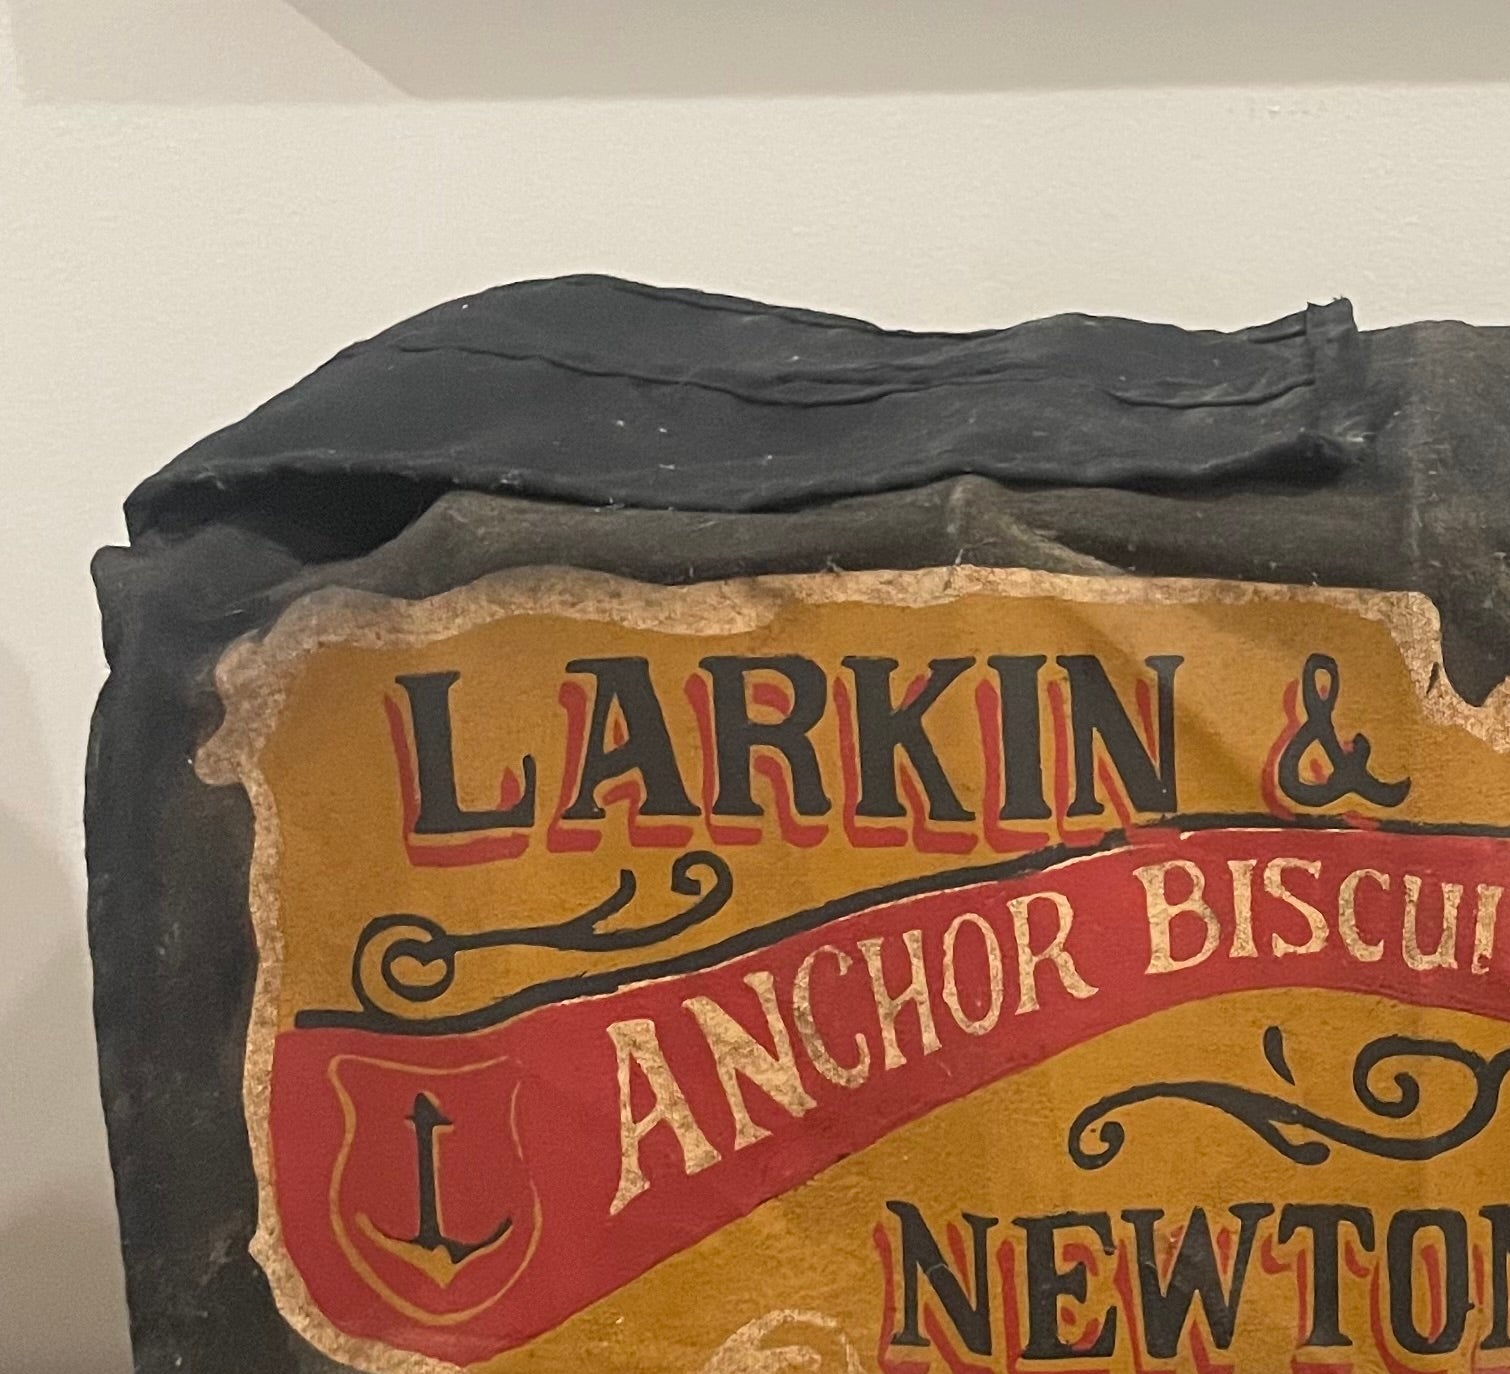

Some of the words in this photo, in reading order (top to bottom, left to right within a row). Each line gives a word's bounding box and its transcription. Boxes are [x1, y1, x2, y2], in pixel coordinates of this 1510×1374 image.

[393, 654, 1185, 836] LARKIN
[1275, 651, 1412, 809] &
[608, 891, 1099, 1216] ANCHOR
